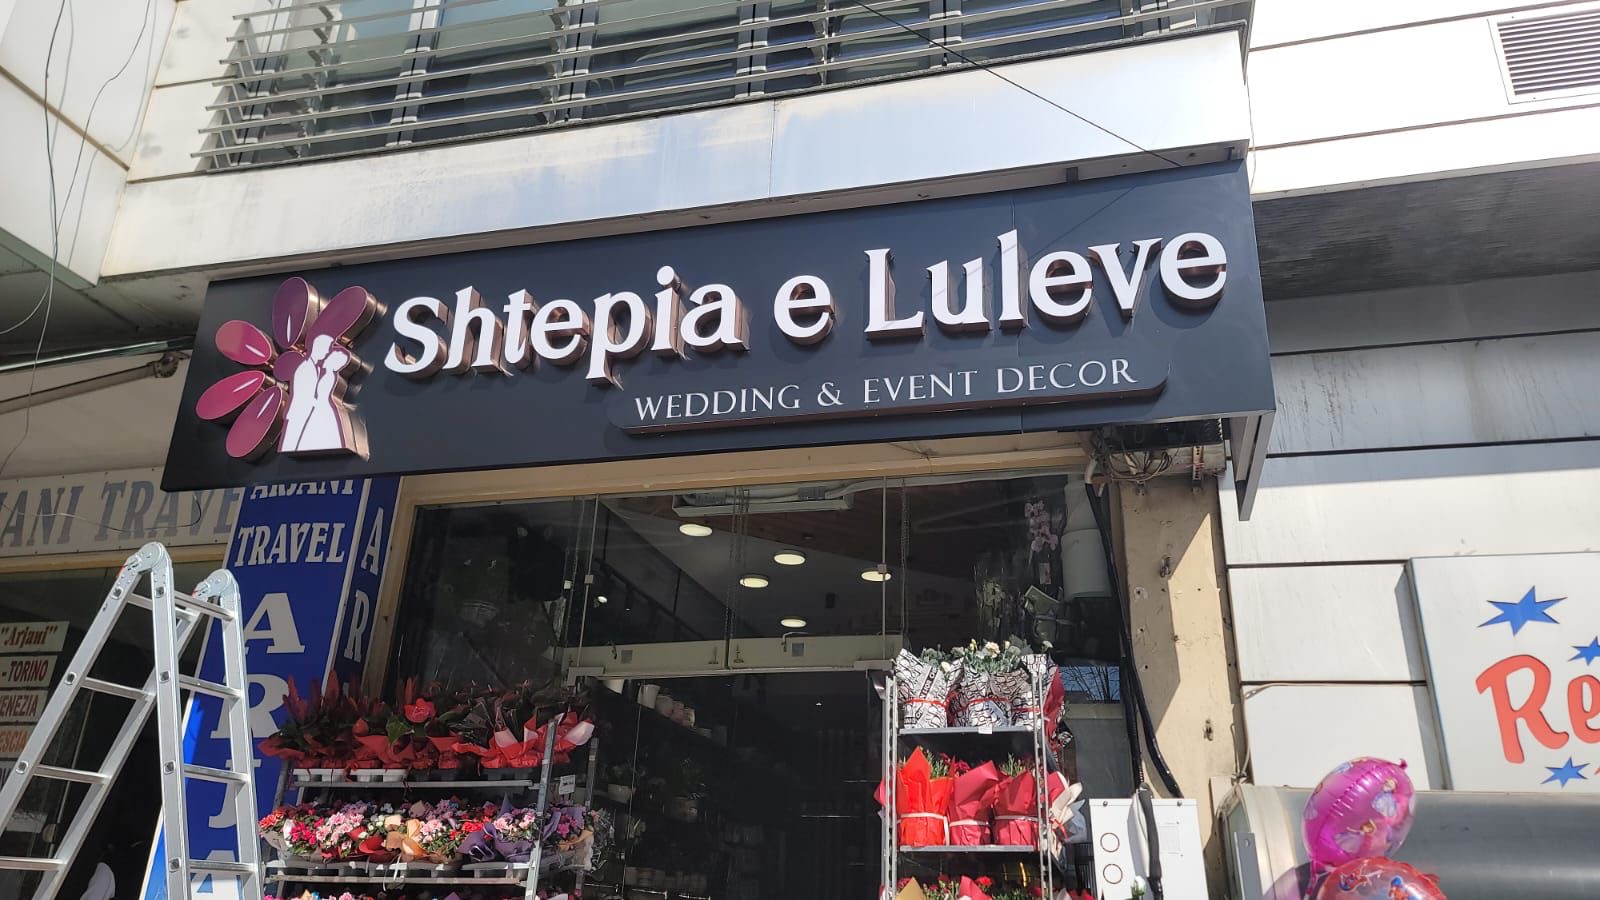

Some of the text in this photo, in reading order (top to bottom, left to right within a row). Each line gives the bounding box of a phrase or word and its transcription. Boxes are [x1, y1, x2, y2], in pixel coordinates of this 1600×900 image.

[384, 229, 1227, 380] Shtepia e Luleve
[634, 359, 1138, 420] WEDDING & EVENT DECOR
[234, 522, 346, 567] TRAVEL
[8, 660, 49, 682] TORINO
[0, 695, 38, 716] ENEZIA
